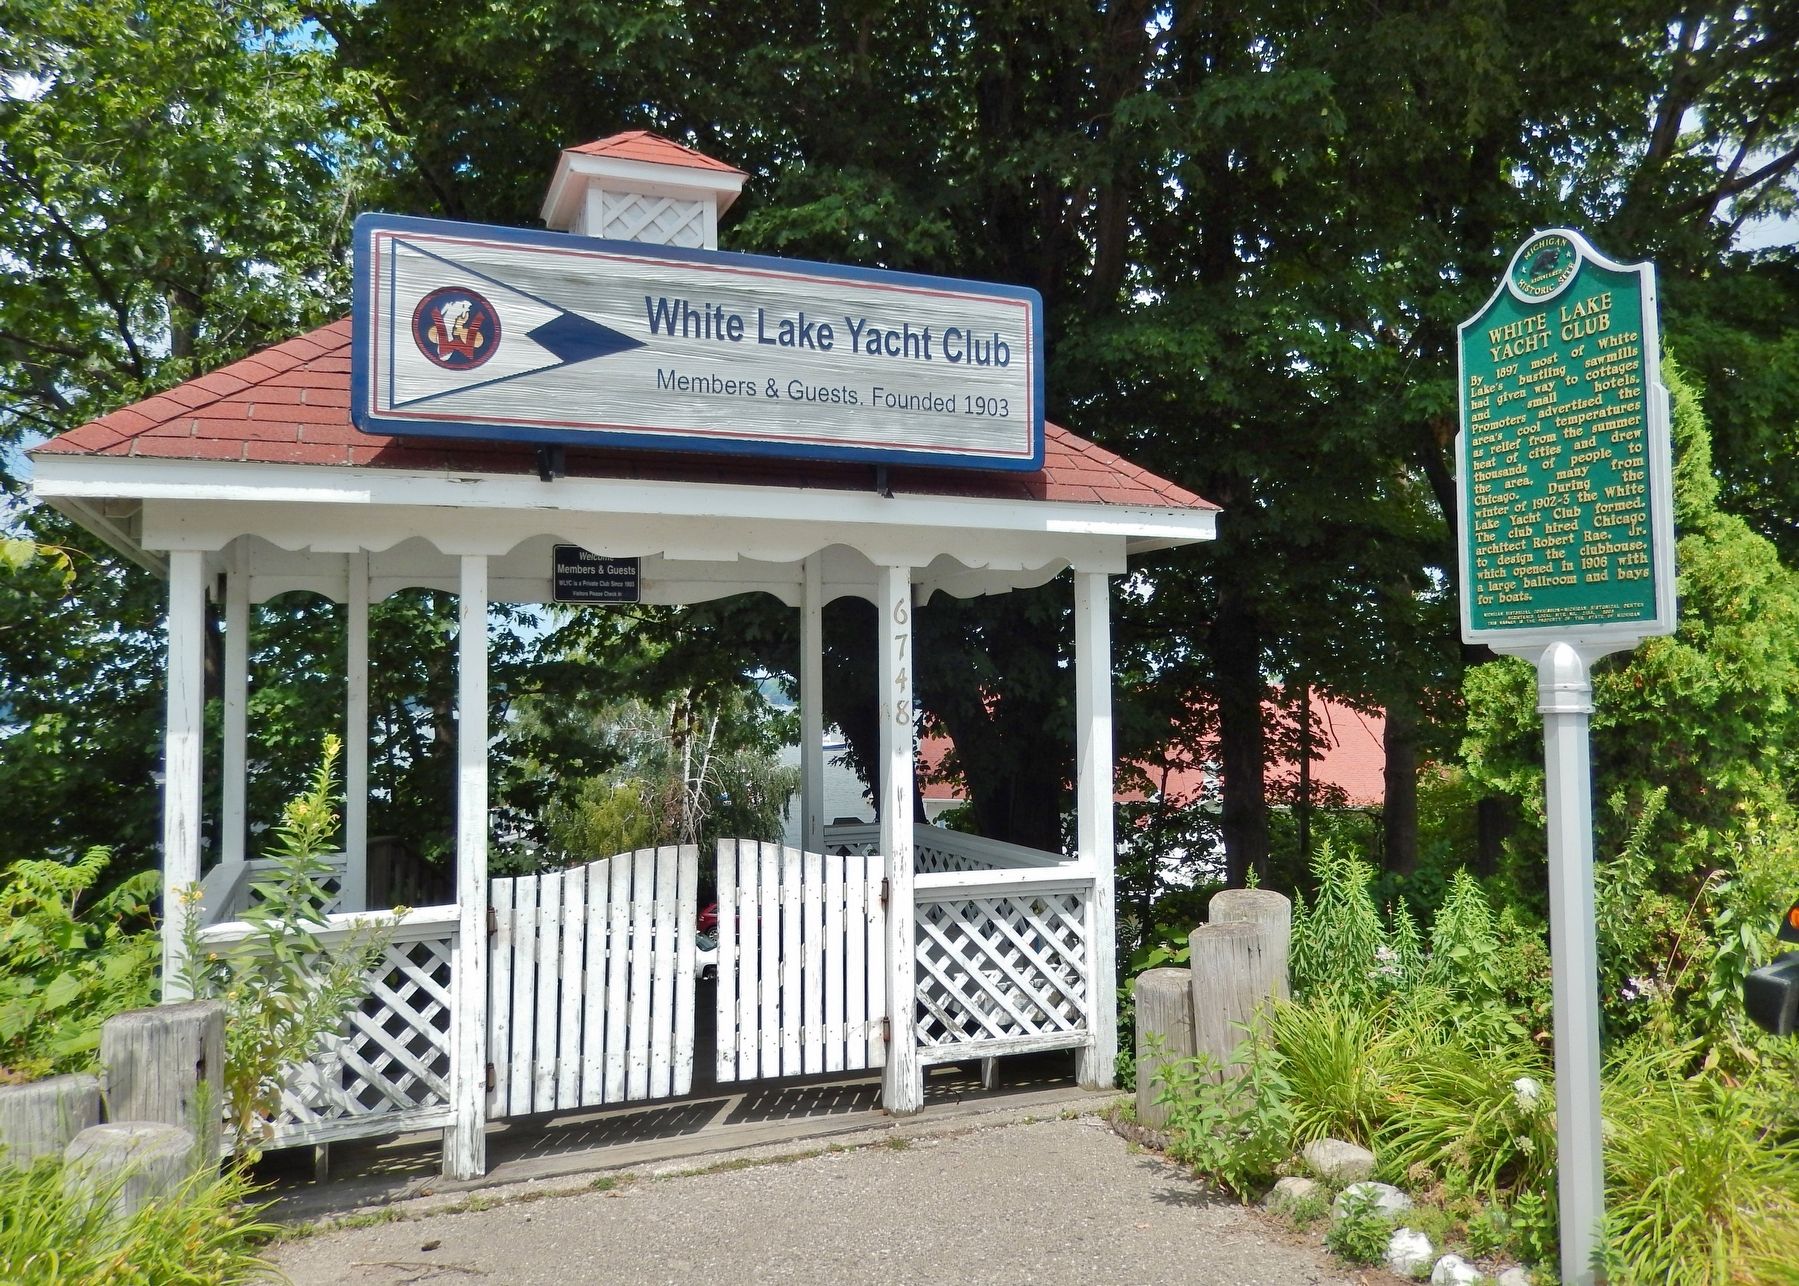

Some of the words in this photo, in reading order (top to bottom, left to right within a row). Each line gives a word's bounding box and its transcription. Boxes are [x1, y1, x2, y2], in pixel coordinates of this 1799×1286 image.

[1524, 237, 1568, 260] MICHIGAN
[1518, 278, 1555, 295] HISTORIC
[1558, 262, 1575, 285] SITE
[645, 295, 745, 342] White
[758, 308, 834, 351] Lake
[845, 316, 932, 360] Yacht
[942, 326, 1011, 367] Club
[1489, 313, 1547, 344] WHITE
[1560, 292, 1612, 323] LAKE
[1490, 331, 1551, 362] YACHT
[1561, 314, 1611, 342] CLUB
[1471, 375, 1484, 387] By
[1496, 363, 1519, 379] 1897
[1531, 352, 1558, 368] most
[1571, 345, 1585, 358] of
[1598, 331, 1638, 349] White
[1471, 381, 1503, 398] Lake's
[1519, 365, 1566, 385] bustling
[1585, 346, 1638, 368] sawmills
[656, 368, 757, 397] Members
[765, 377, 779, 398] &
[787, 379, 864, 406] Guests.
[872, 387, 956, 413] Founded
[963, 395, 1009, 417] 1903
[1471, 398, 1490, 410] had
[1497, 389, 1526, 405] given
[1534, 381, 1555, 394] way
[1565, 374, 1578, 386] to
[1586, 360, 1639, 381] cottages
[1472, 410, 1490, 422] and
[1527, 393, 1556, 409] small
[1594, 373, 1640, 393] hotels.
[1472, 414, 1526, 434] Promoters
[1538, 395, 1603, 419] advertised
[1618, 386, 1641, 400] the
[1472, 433, 1503, 447] area's
[1517, 422, 1541, 437] cool
[1555, 400, 1641, 427] temperatures
[1472, 449, 1484, 458] as
[1491, 438, 1521, 455] relief
[1529, 432, 1557, 446] from
[1563, 427, 1584, 439] the
[1592, 416, 1641, 433] summer
[1473, 458, 1496, 471] heat
[1506, 452, 1518, 464] of
[1529, 445, 1562, 460] cities
[1574, 437, 1597, 450] and
[1611, 429, 1642, 443] drew
[1474, 464, 1527, 482] thousands
[1542, 458, 1555, 470] of
[1570, 448, 1612, 467] people
[1628, 442, 1643, 453] to
[1474, 483, 1492, 494] the
[1556, 466, 1589, 480] many
[1611, 457, 1644, 471] from
[1474, 491, 1520, 507] Chicago.
[1548, 479, 1591, 495] During
[1622, 469, 1644, 482] the
[1474, 505, 1509, 518] winter
[1514, 501, 1528, 512] of
[1532, 495, 1570, 510] 1902-3
[1577, 490, 1598, 503] the
[1604, 483, 1645, 498] White
[1475, 518, 1500, 531] Lake
[1509, 511, 1541, 526] Yacht
[1553, 506, 1582, 519] Club
[1594, 498, 1646, 514] formed.
[1475, 531, 1496, 543] The
[1508, 526, 1533, 539] club
[1545, 519, 1578, 534] hired
[1593, 512, 1646, 528] Chicago
[1476, 540, 1526, 556] architect
[1533, 533, 1574, 549] Robert
[1628, 524, 1647, 537] Jr.
[1476, 557, 1488, 568] to
[1497, 551, 1534, 567] design
[1546, 548, 1566, 560] the
[557, 564, 595, 574] Members
[598, 565, 604, 574] &
[607, 565, 636, 575] Guests
[1476, 566, 1507, 580] which
[1513, 562, 1553, 578] opened
[1561, 560, 1574, 572] in
[1581, 556, 1608, 570] 1906
[1617, 552, 1648, 565] with
[1477, 583, 1484, 592] a
[1488, 578, 1517, 592] large
[1523, 573, 1577, 588] ballroom
[1585, 569, 1609, 582] and
[1617, 566, 1649, 580] bays
[1477, 594, 1494, 605] for
[1499, 591, 1533, 603] boats.
